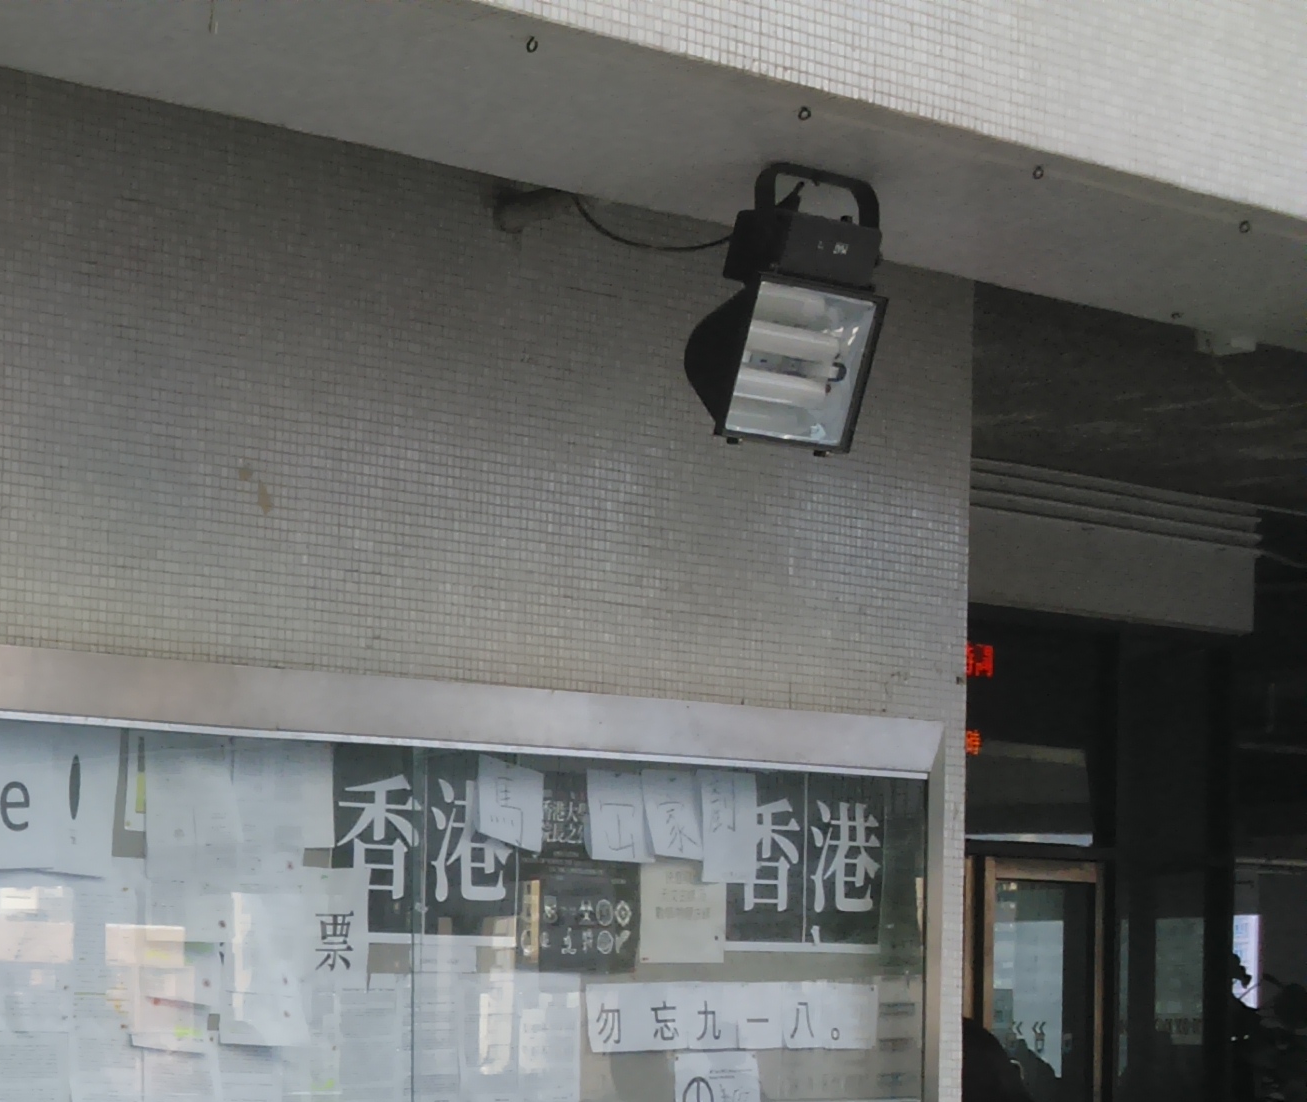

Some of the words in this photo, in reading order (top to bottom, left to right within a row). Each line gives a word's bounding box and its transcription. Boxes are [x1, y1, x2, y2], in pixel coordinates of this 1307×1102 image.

[337, 774, 513, 902] 香港
[744, 799, 880, 912] 香港
[315, 910, 354, 971] 票
[596, 1001, 840, 1045] 勿忘九一八。
